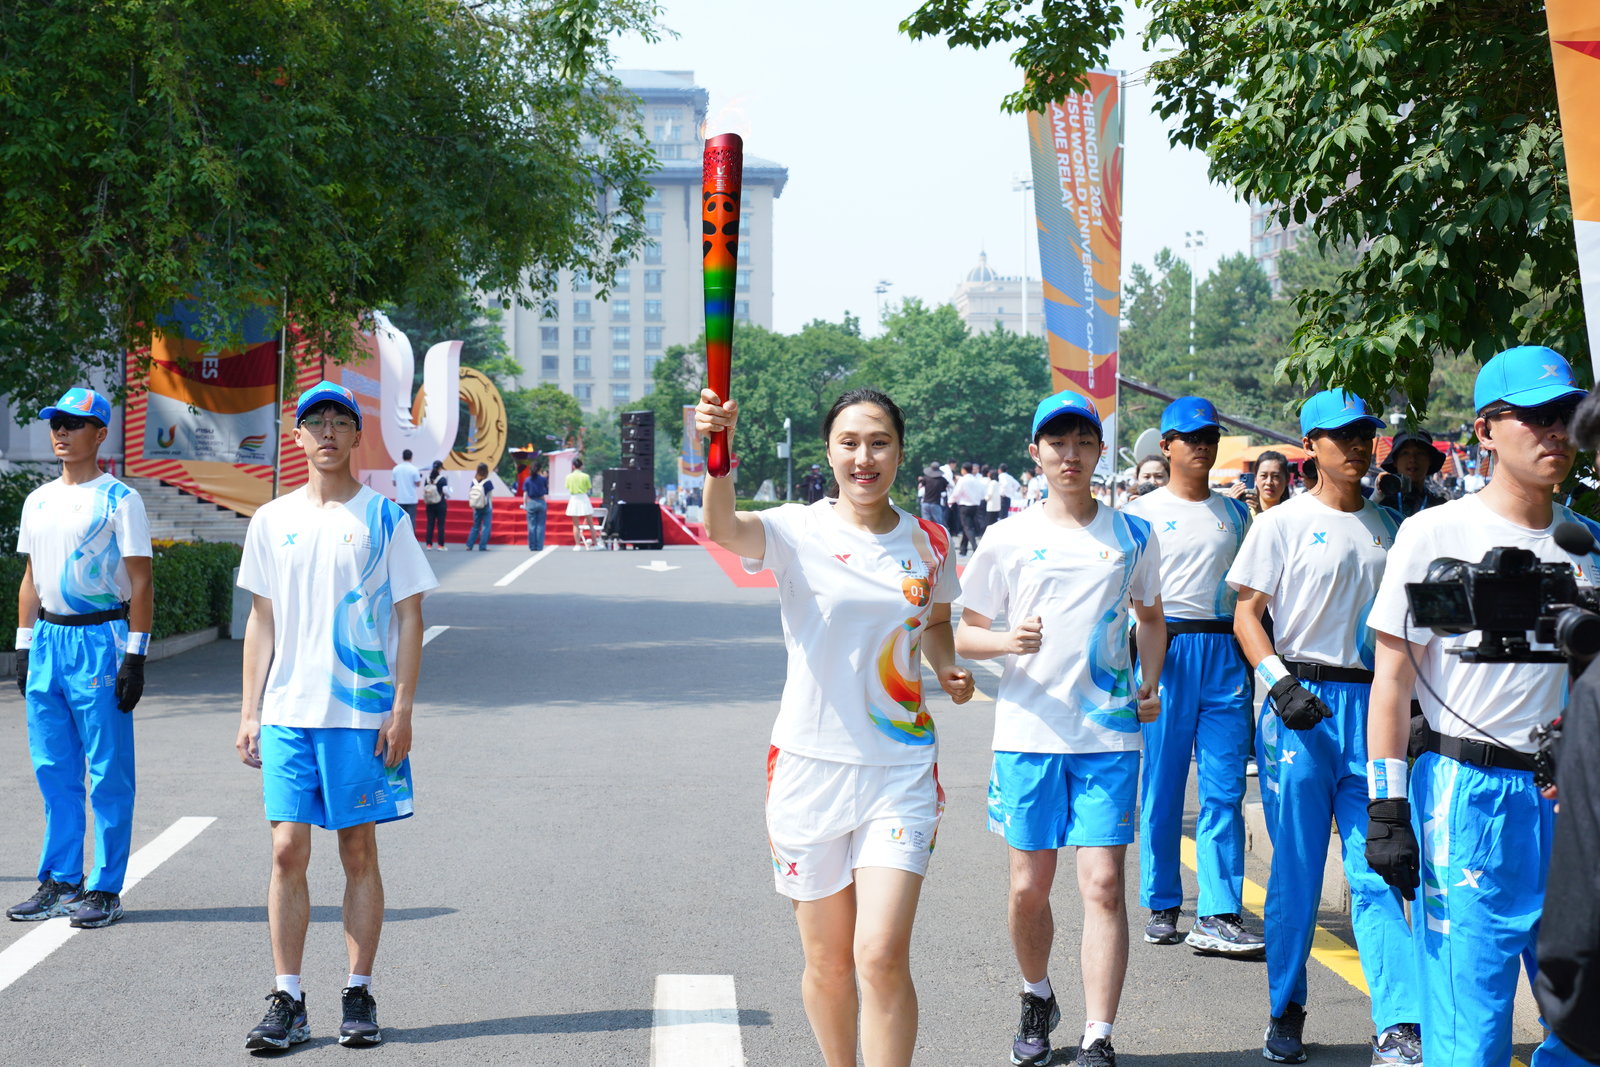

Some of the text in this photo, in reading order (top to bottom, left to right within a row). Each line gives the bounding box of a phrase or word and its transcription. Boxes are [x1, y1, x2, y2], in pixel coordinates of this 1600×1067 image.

[1050, 98, 1075, 213] AME RELAY
[1070, 131, 1087, 202] WORLD
[1081, 89, 1102, 227] CHENGDU 2021
[1078, 206, 1094, 319] UNIVERSITY
[1086, 322, 1095, 389] GAMES
[910, 585, 925, 599] 01
